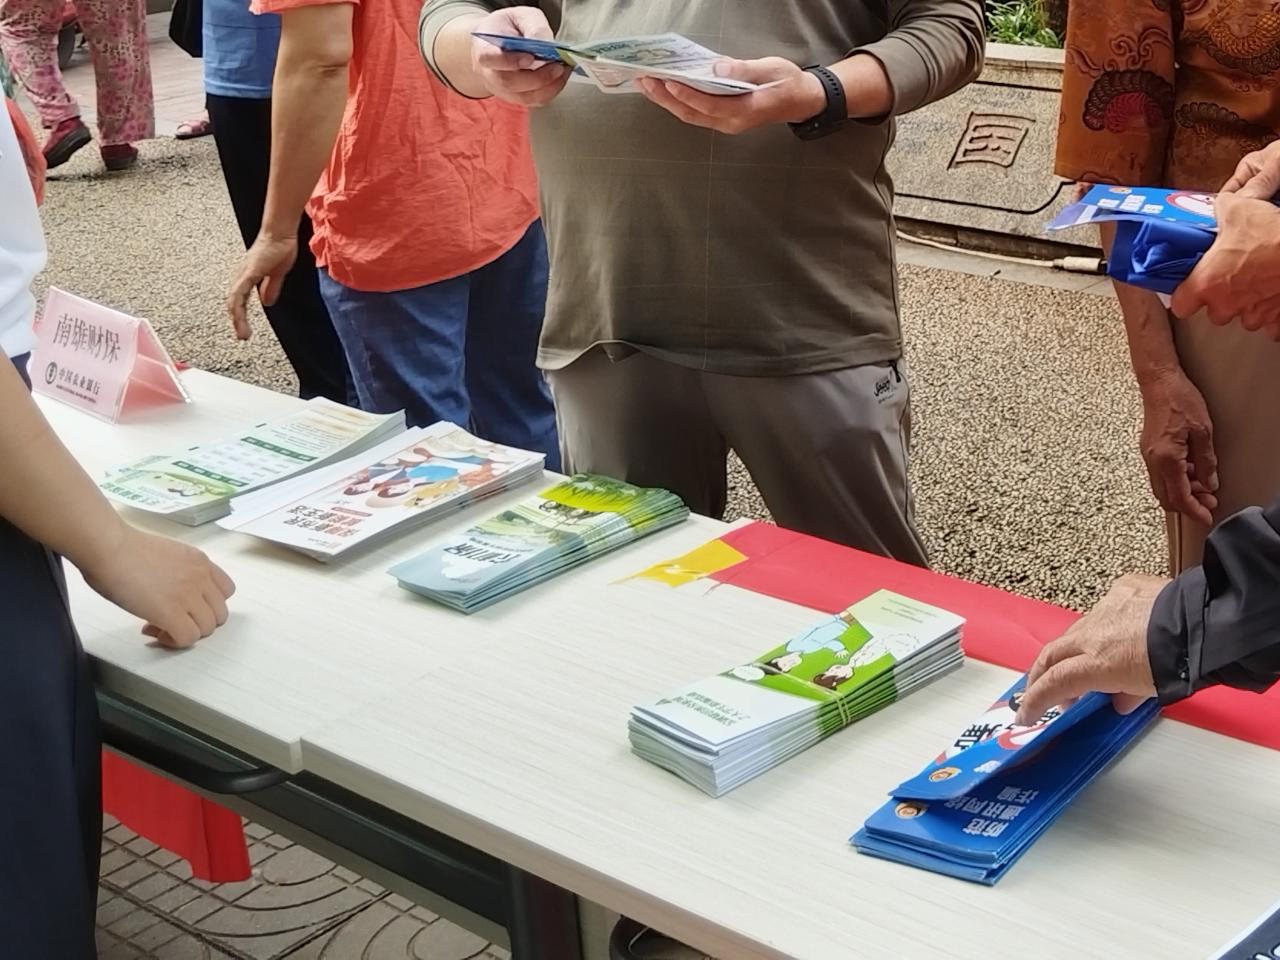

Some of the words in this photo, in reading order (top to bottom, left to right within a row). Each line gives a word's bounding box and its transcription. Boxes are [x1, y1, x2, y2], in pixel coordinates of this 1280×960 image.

[53, 313, 121, 363] 南雄财保
[996, 785, 1040, 804] 诈骗
[944, 795, 1026, 822] 通讯网络
[962, 817, 1010, 837] 防范
